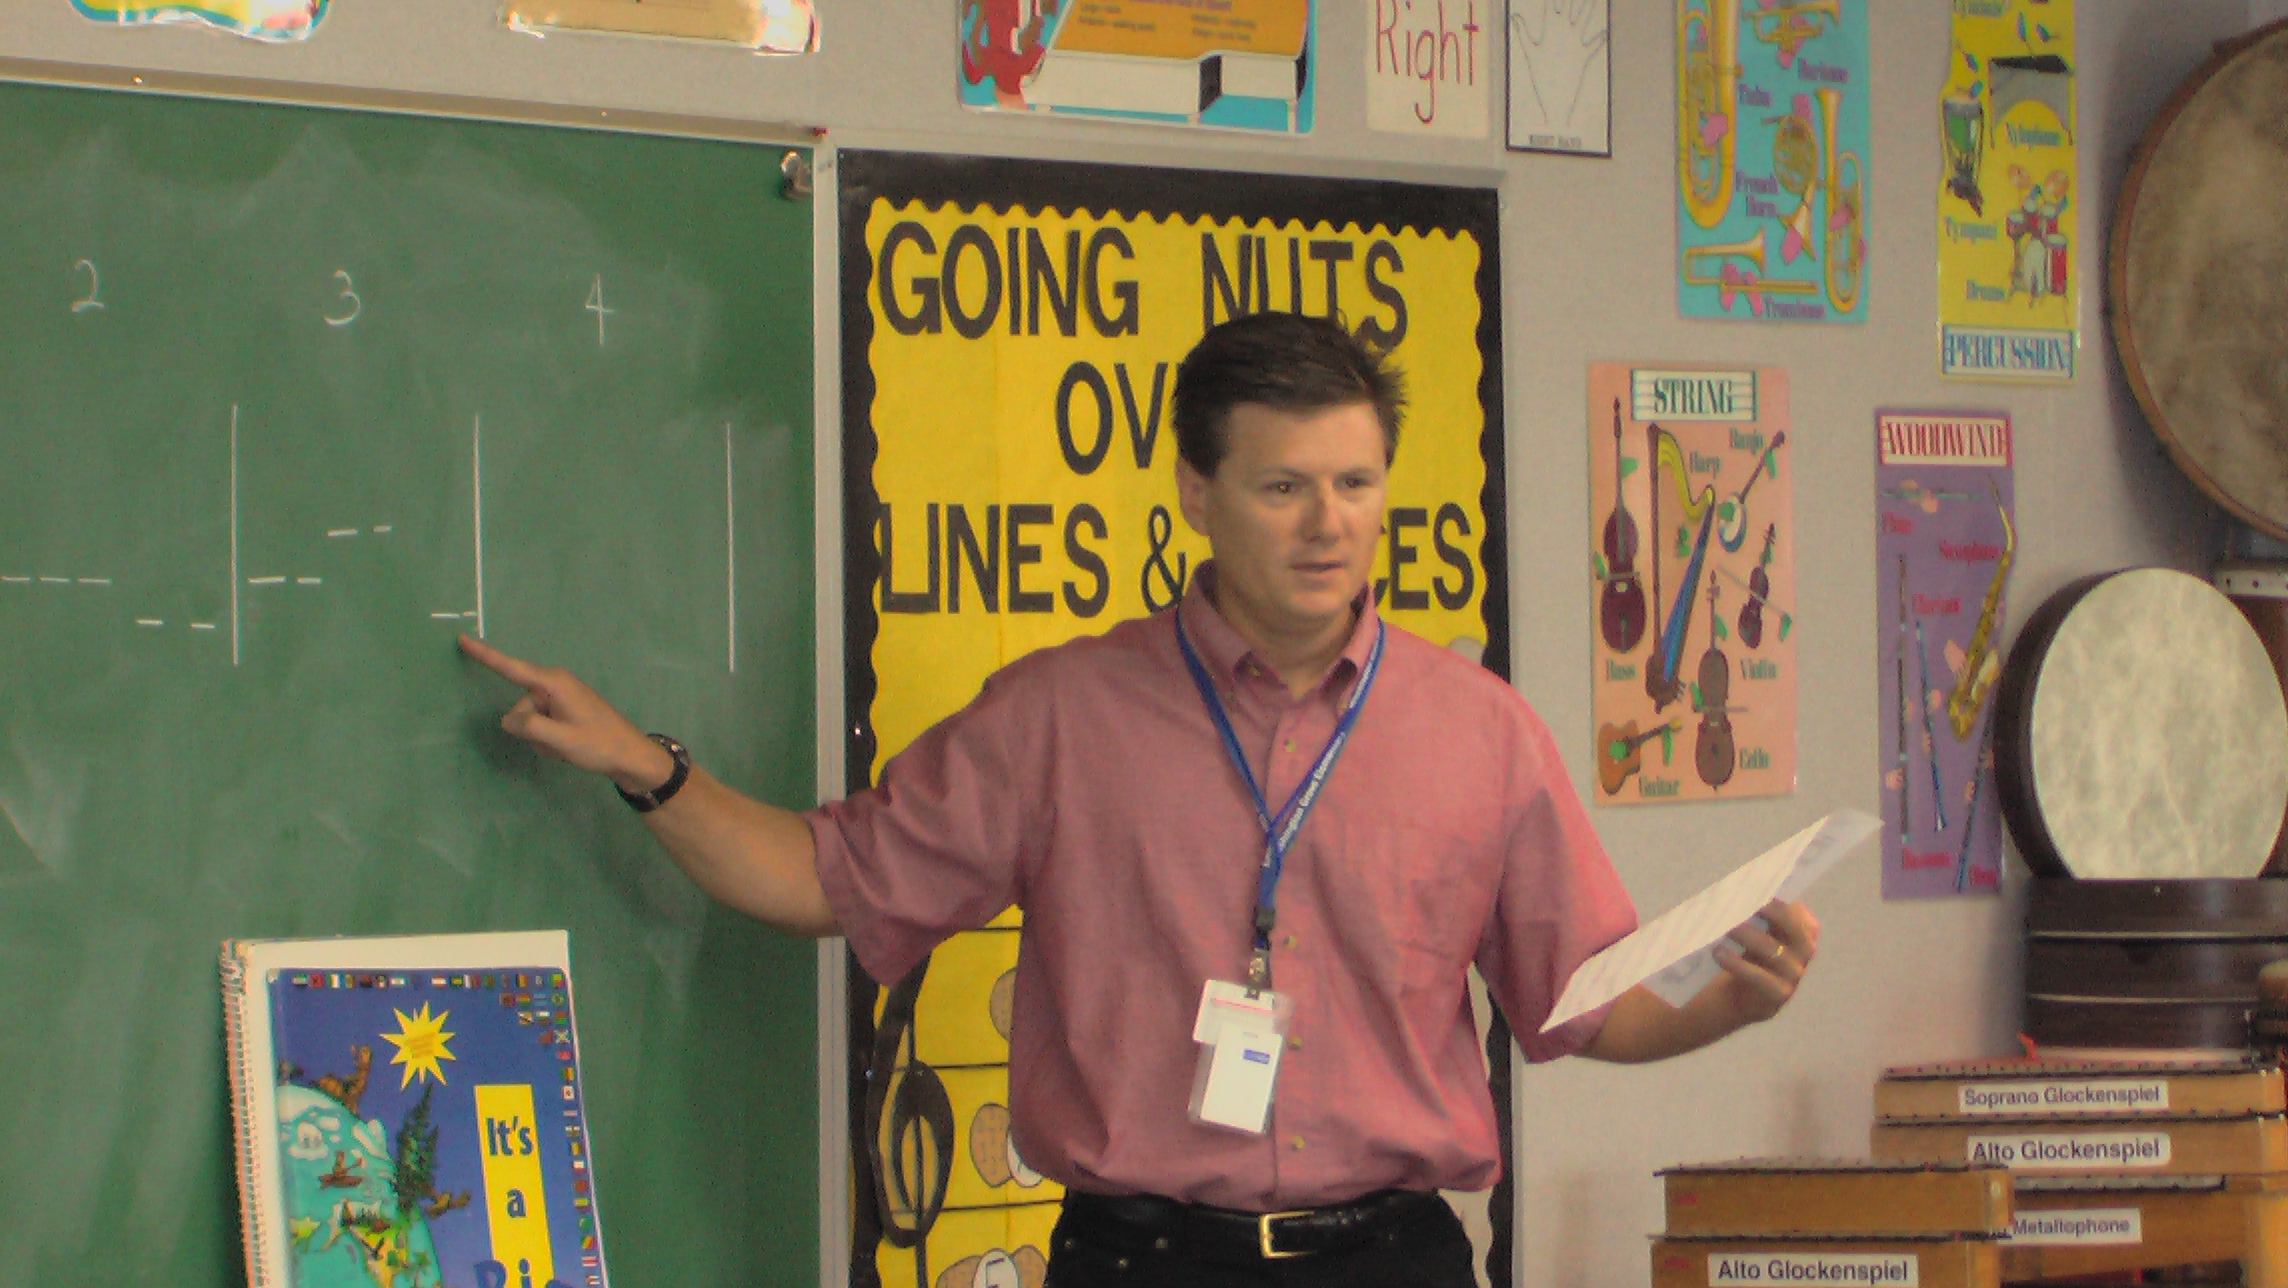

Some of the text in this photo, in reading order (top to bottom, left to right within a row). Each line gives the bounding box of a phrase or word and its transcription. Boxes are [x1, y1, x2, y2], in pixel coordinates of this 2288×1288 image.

[1375, 0, 1480, 124] Right
[71, 258, 615, 347] 2 3 4
[878, 221, 1408, 349] GOING NUTS
[1653, 377, 1733, 414] STRING
[1055, 361, 1184, 476] OV
[1885, 421, 2004, 457] WOODWIND
[880, 502, 1475, 618] LINES & ES
[1964, 1085, 2160, 1109] Soprano Glockenspiel
[486, 1116, 533, 1157] It's
[1973, 1137, 2161, 1163] Alto Glockenspiel
[506, 1188, 527, 1219] a
[1717, 1259, 1908, 1285] Alto Glockenspiel
